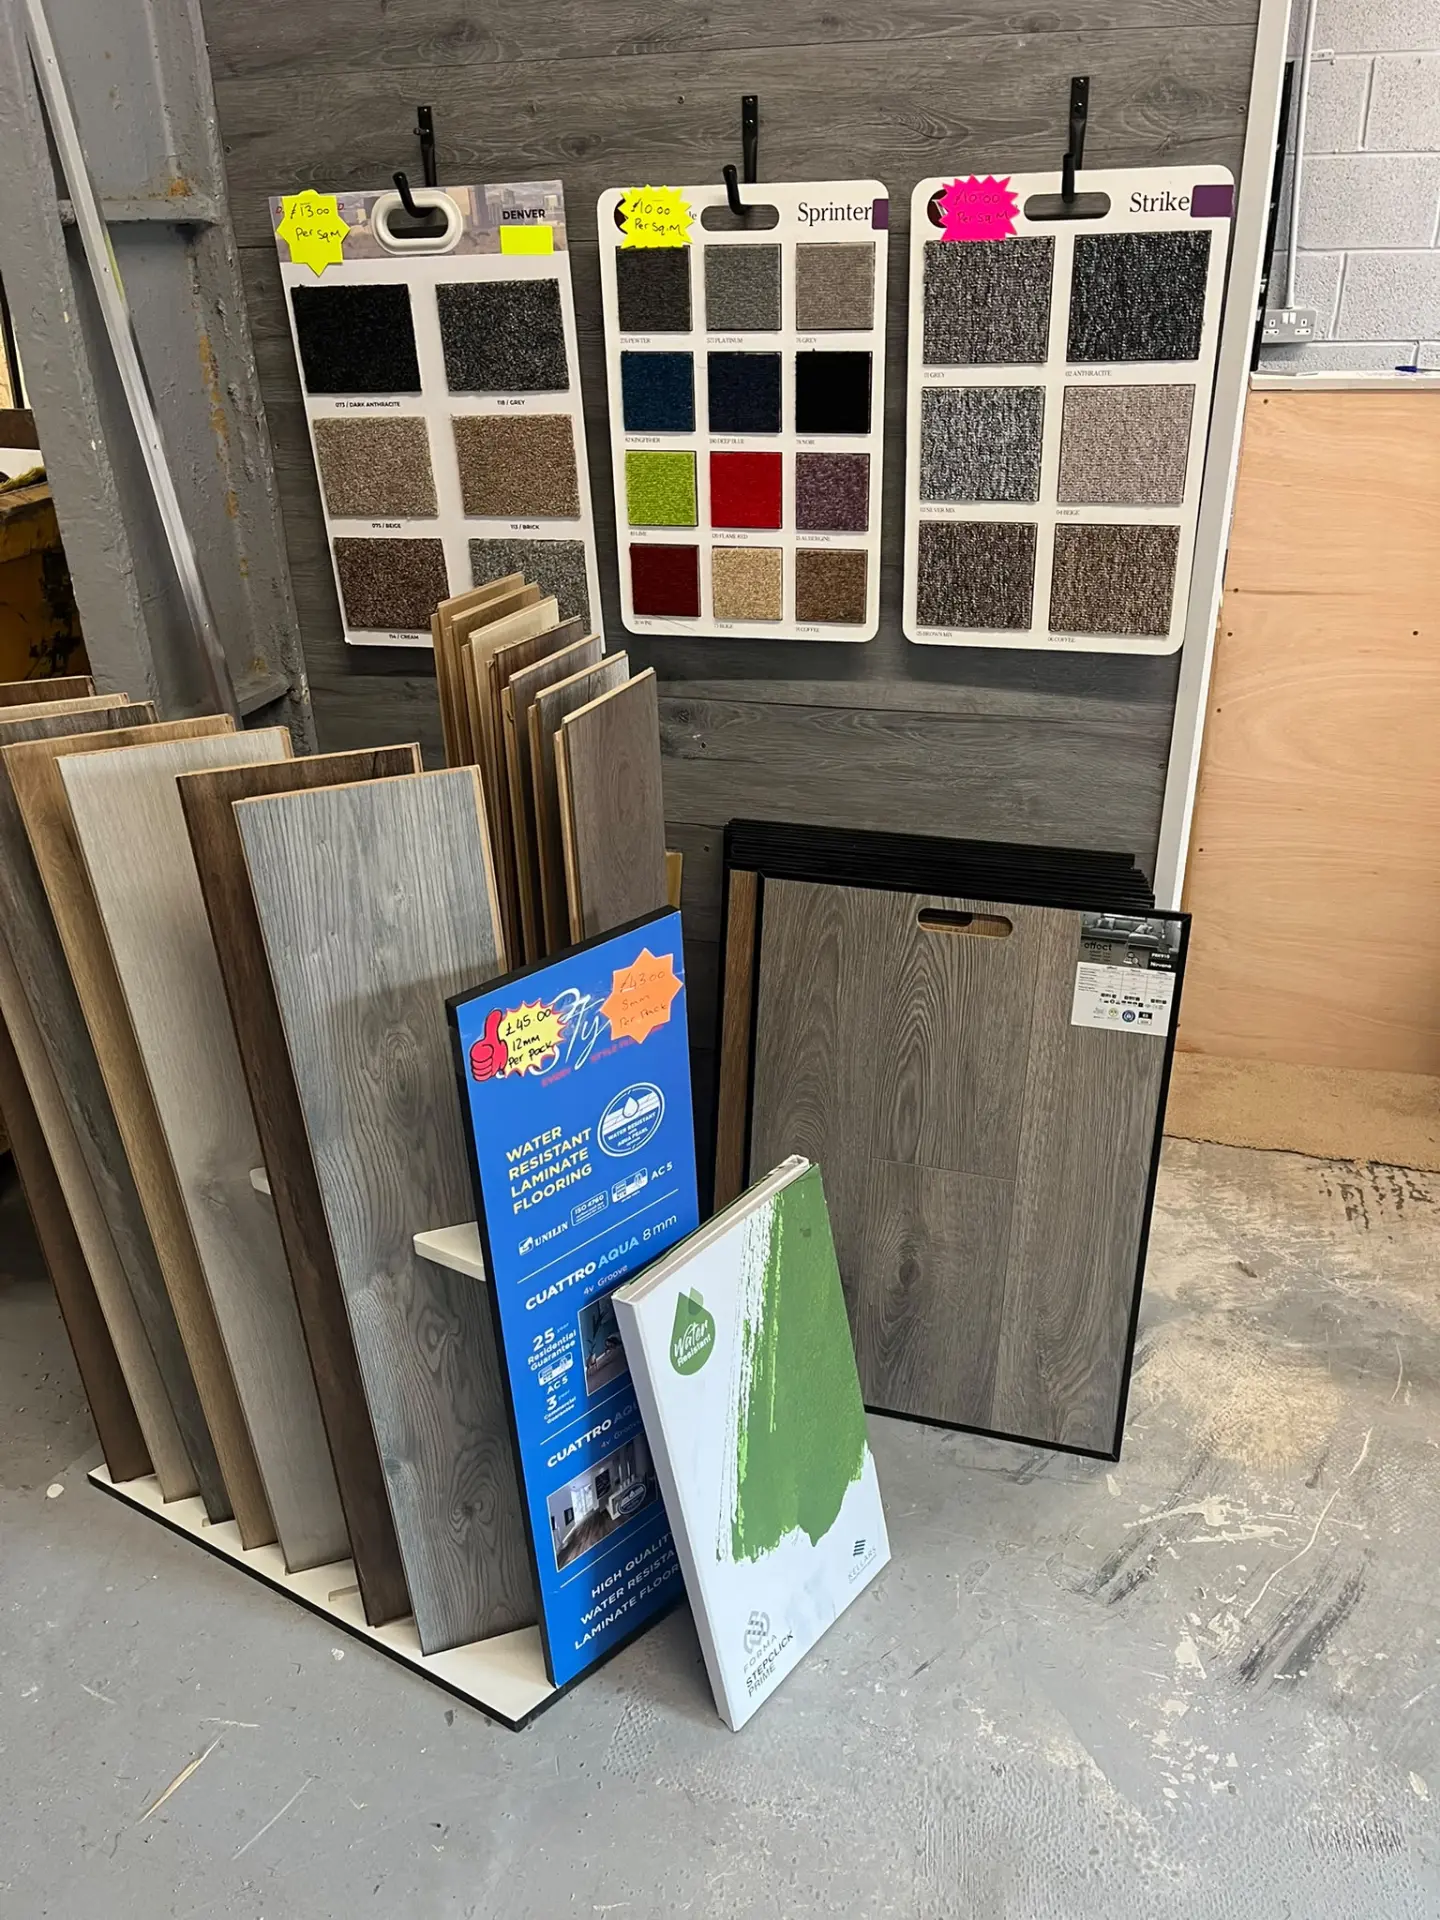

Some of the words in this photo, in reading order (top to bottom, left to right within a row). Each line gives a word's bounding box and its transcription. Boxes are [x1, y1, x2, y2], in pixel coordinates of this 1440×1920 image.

[502, 208, 546, 220] DENVER
[797, 201, 872, 227] Sprinter
[1129, 191, 1190, 213] Strike
[635, 217, 649, 230] Per
[620, 1016, 636, 1029] Per
[640, 1003, 668, 1019] Pack
[508, 1054, 524, 1069] Per
[528, 1041, 553, 1060] Pack
[512, 1034, 541, 1052] 12mm
[505, 1125, 563, 1163] WATER
[508, 1126, 592, 1181] RESISTANT
[511, 1146, 589, 1199] LAMINATE
[650, 1166, 666, 1181] AC
[666, 1161, 673, 1171] 5
[513, 1163, 592, 1215] FLOORING
[574, 1204, 587, 1215] ISO
[534, 1220, 569, 1247] UNILIN
[525, 1261, 597, 1311] CUATTRO
[598, 1236, 640, 1269] AQUA
[583, 1285, 594, 1296] 4v
[597, 1264, 628, 1288] Groove
[527, 1329, 577, 1366] Residential
[532, 1327, 555, 1353] 25
[674, 1319, 709, 1358] Water
[677, 1333, 712, 1368] Resistant
[530, 1340, 576, 1372] Guarantee
[546, 1381, 561, 1395] AC
[561, 1375, 569, 1385] 5
[546, 1394, 558, 1412] 3
[547, 1418, 612, 1468] CUATTRO
[591, 1569, 623, 1599] HIGH
[625, 1532, 672, 1572] QUALIT
[580, 1587, 625, 1625] WATER
[627, 1549, 676, 1590] RESISTA
[574, 1595, 637, 1650] LAMINATE
[639, 1563, 680, 1600] FLOOR
[743, 1633, 778, 1674] FORMA
[746, 1629, 794, 1689] STEPCLICK
[748, 1662, 776, 1698] PRIME
